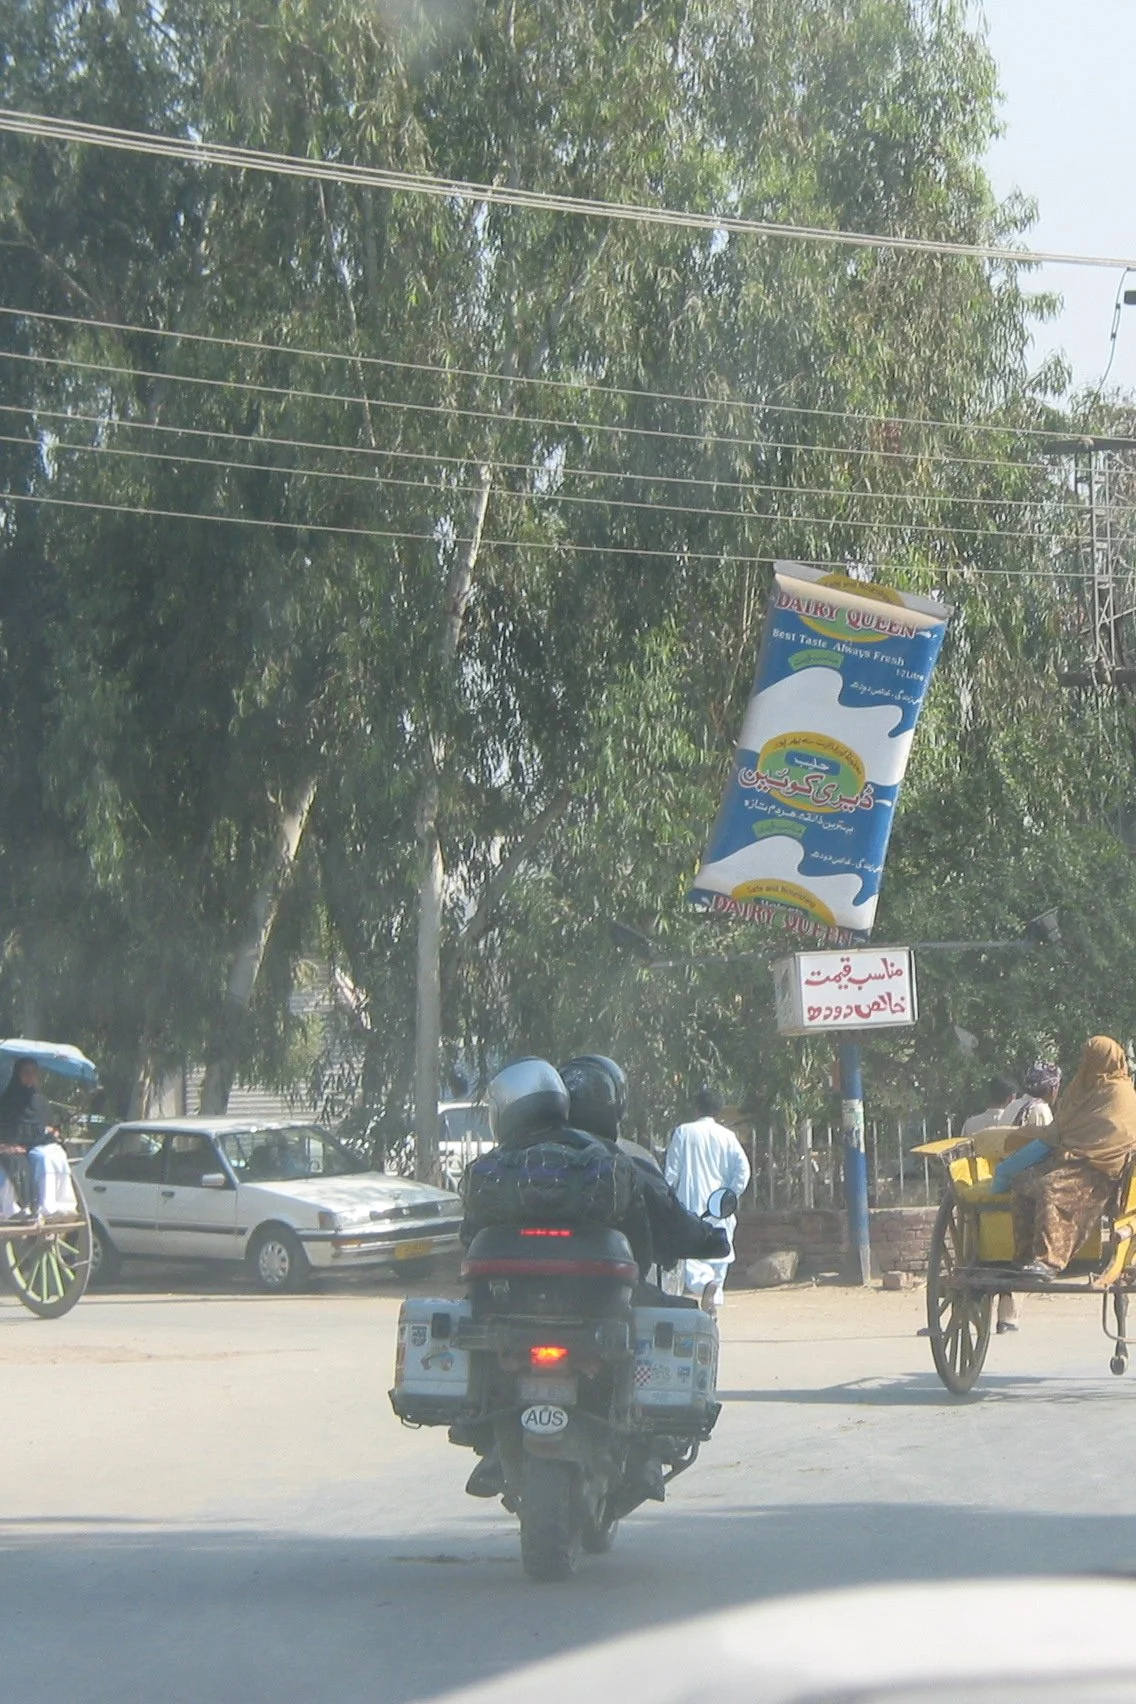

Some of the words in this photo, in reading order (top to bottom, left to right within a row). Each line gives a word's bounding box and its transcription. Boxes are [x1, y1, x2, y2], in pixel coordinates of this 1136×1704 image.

[775, 591, 839, 620] DAIRY
[846, 608, 917, 639] QUEEN
[772, 628, 796, 641] Best
[799, 633, 828, 648] Taste
[832, 642, 870, 658] Always
[873, 650, 904, 666] Fresh
[811, 783, 874, 813] ڈیری
[805, 957, 852, 989] قیمت
[847, 958, 903, 990] مناسب
[807, 1005, 853, 1021] دودھ
[855, 992, 905, 1019] خالص
[526, 1409, 563, 1426] AUS
